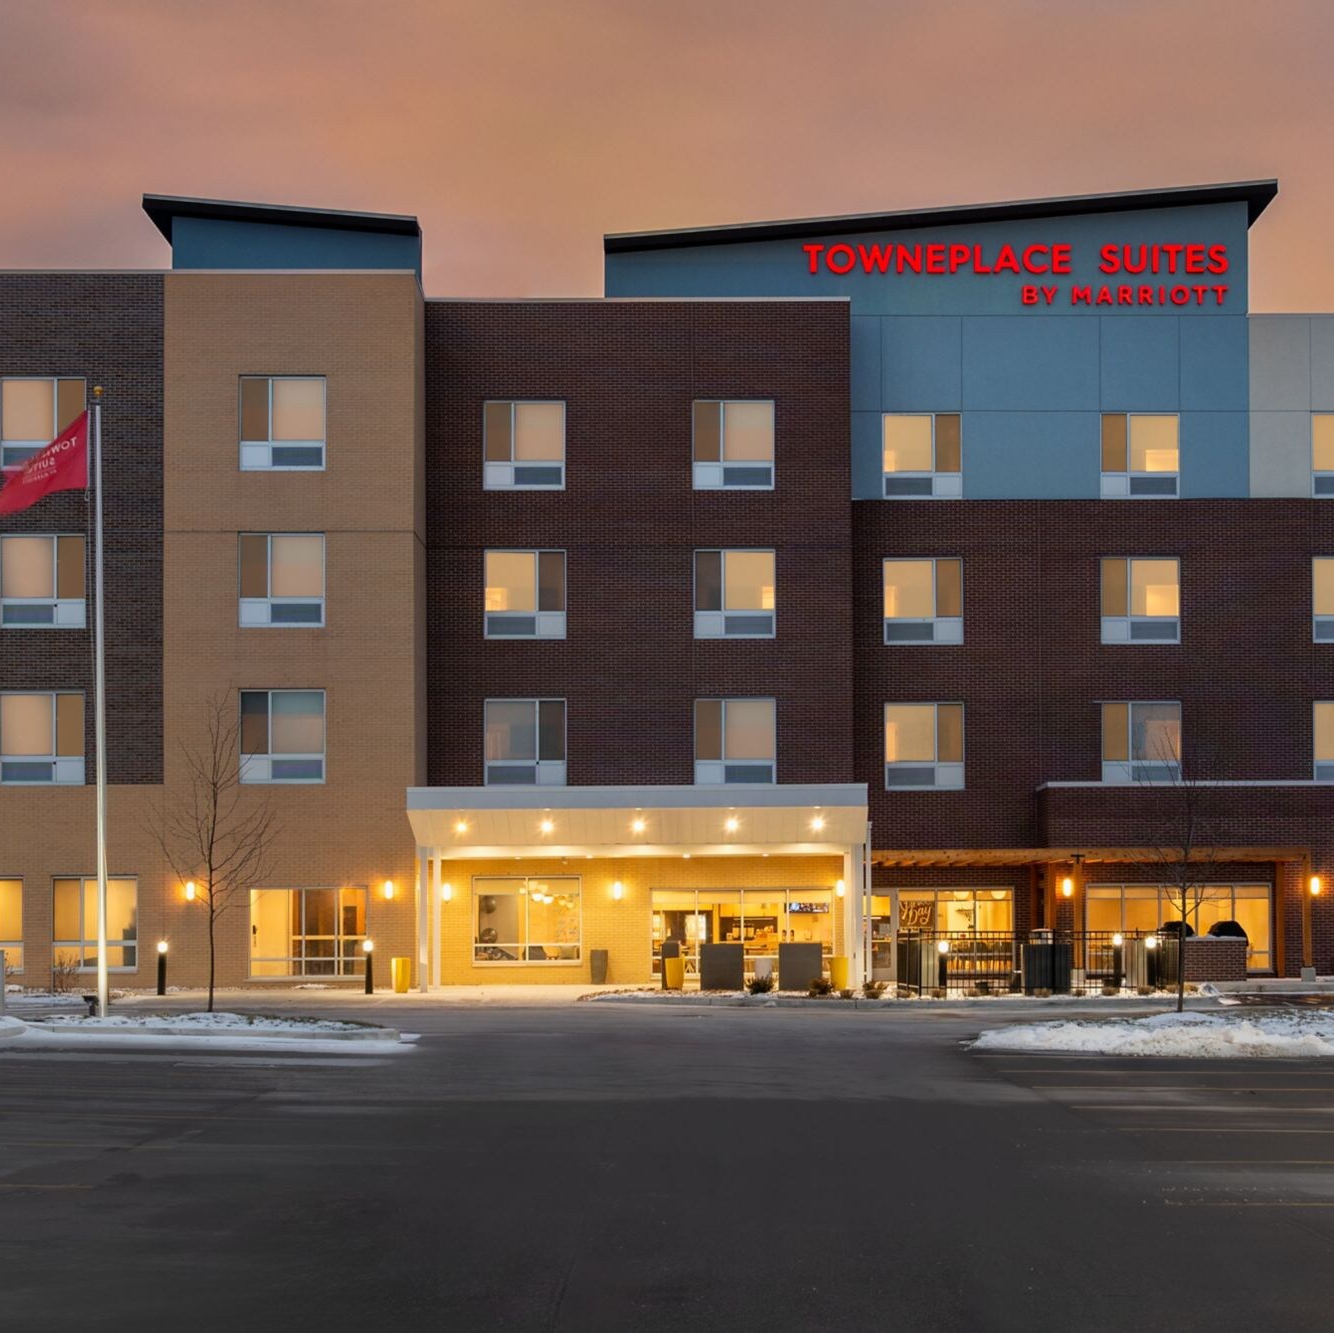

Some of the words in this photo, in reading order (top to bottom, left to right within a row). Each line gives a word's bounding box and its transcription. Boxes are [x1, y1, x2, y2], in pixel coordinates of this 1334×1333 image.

[803, 243, 1072, 275] TOWNEPLACE
[1099, 243, 1229, 275] SUITES
[1022, 285, 1058, 305] BY
[1071, 285, 1229, 305] MARRIOTT
